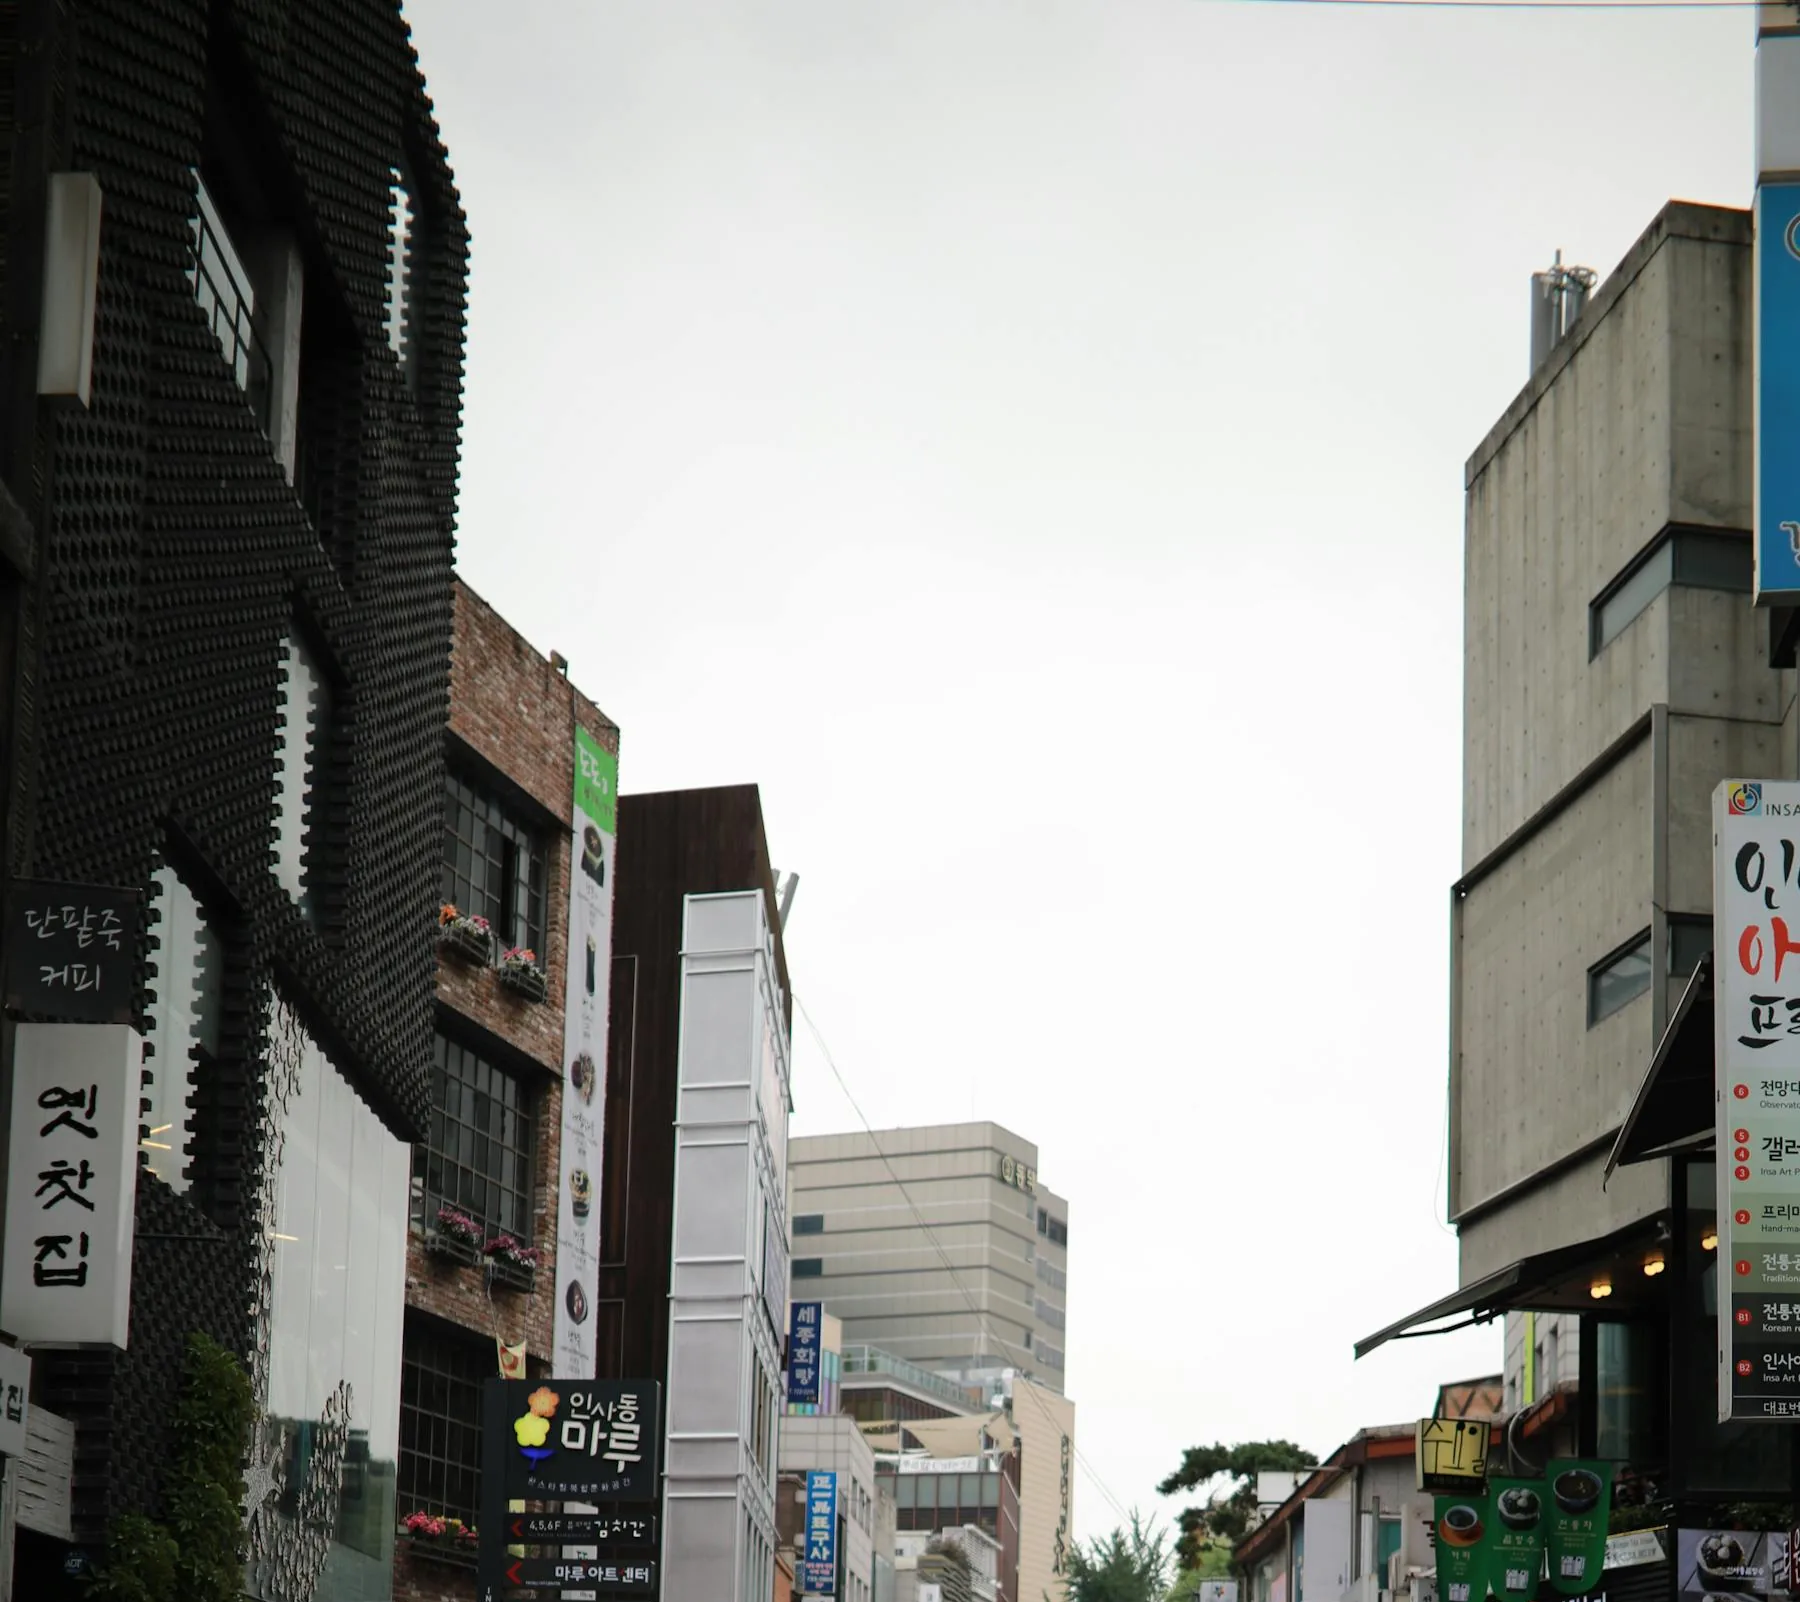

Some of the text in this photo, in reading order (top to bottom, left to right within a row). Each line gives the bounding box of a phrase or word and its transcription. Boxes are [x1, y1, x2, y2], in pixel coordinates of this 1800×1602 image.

[1735, 838, 1800, 909] 인
[25, 905, 123, 951] 단팥죽
[41, 961, 101, 992] 커피
[33, 1083, 100, 1287] 옛찻집
[1761, 1168, 1776, 1176] Insa
[1779, 1168, 1792, 1176] Art
[1737, 1313, 1748, 1322] B1
[1762, 1323, 1792, 1332] Korean
[793, 1306, 816, 1386] 세종화랑
[1739, 1363, 1750, 1372] B2
[1763, 1374, 1795, 1382] Insa Art
[0, 1379, 23, 1424] 집
[569, 1392, 639, 1422] 인사동
[561, 1420, 642, 1473] 마루
[594, 1520, 646, 1538] 김치간
